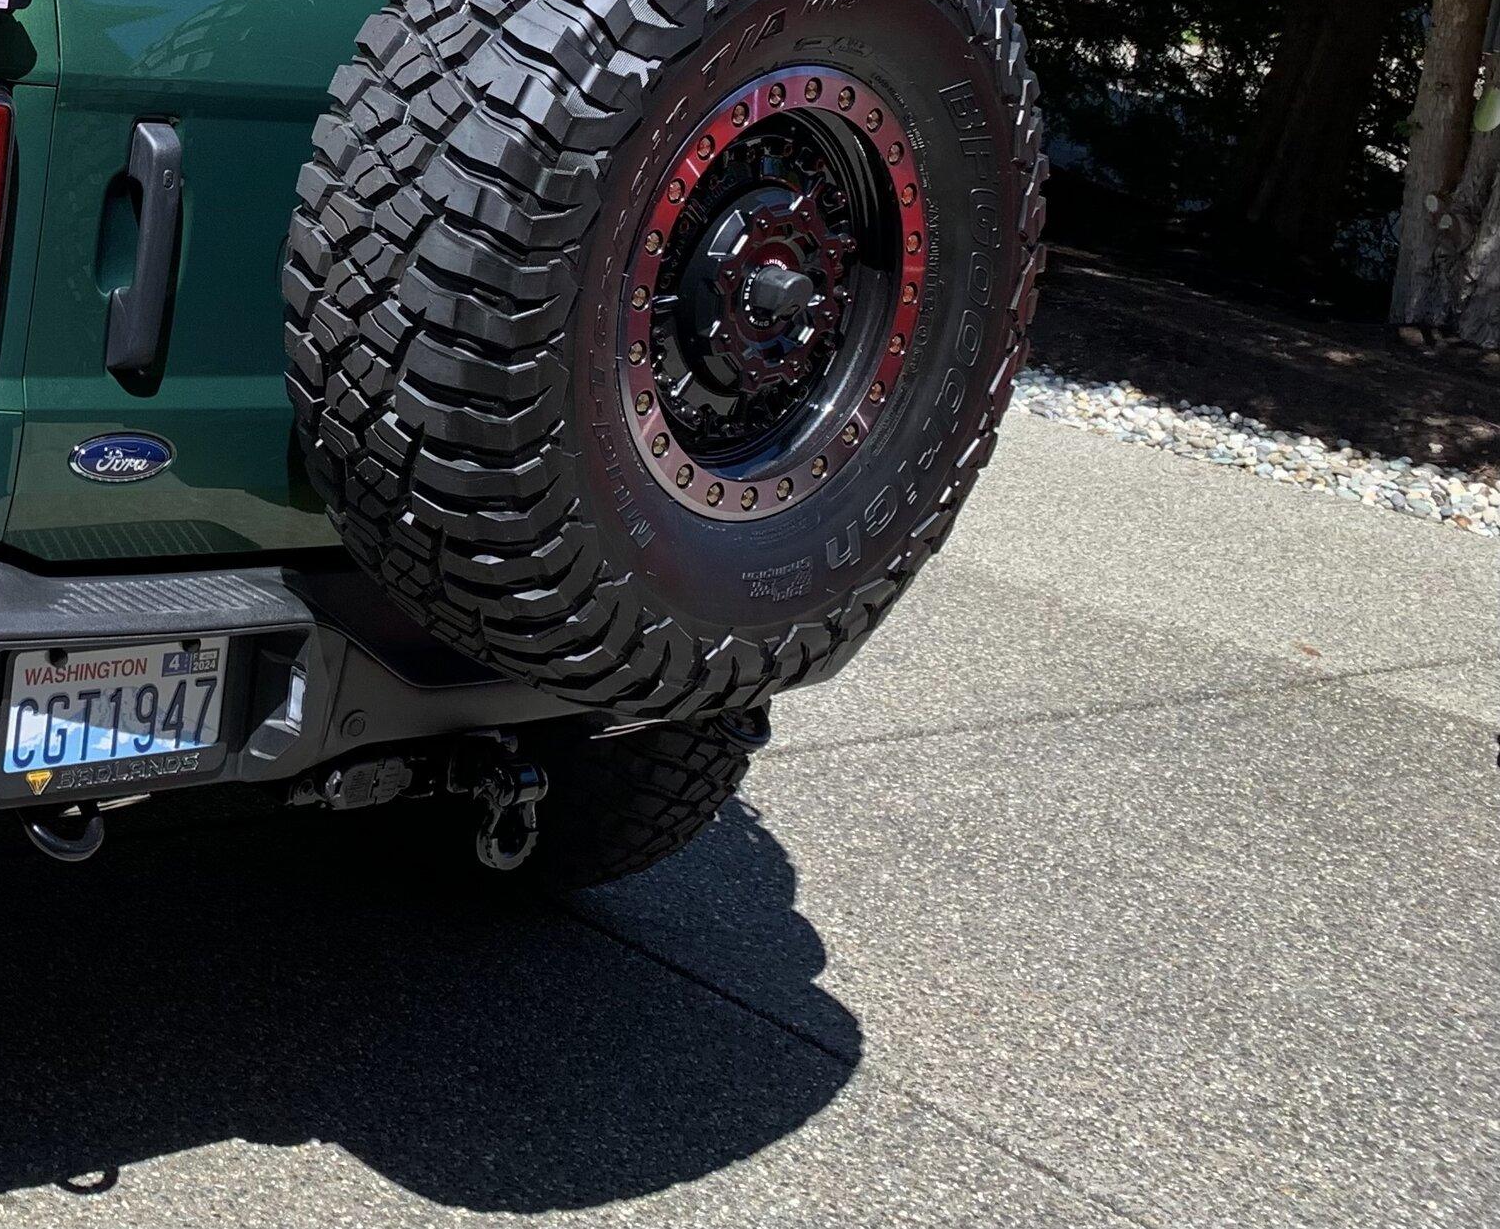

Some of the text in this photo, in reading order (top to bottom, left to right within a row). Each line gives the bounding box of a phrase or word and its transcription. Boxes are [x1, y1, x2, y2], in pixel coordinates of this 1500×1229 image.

[96, 446, 151, 472] Ford
[24, 657, 149, 686] WASHINGTON
[169, 654, 180, 671] 4
[192, 659, 216, 672] 2024
[12, 675, 218, 770] CGT1947
[56, 752, 200, 790] BADLANDS
